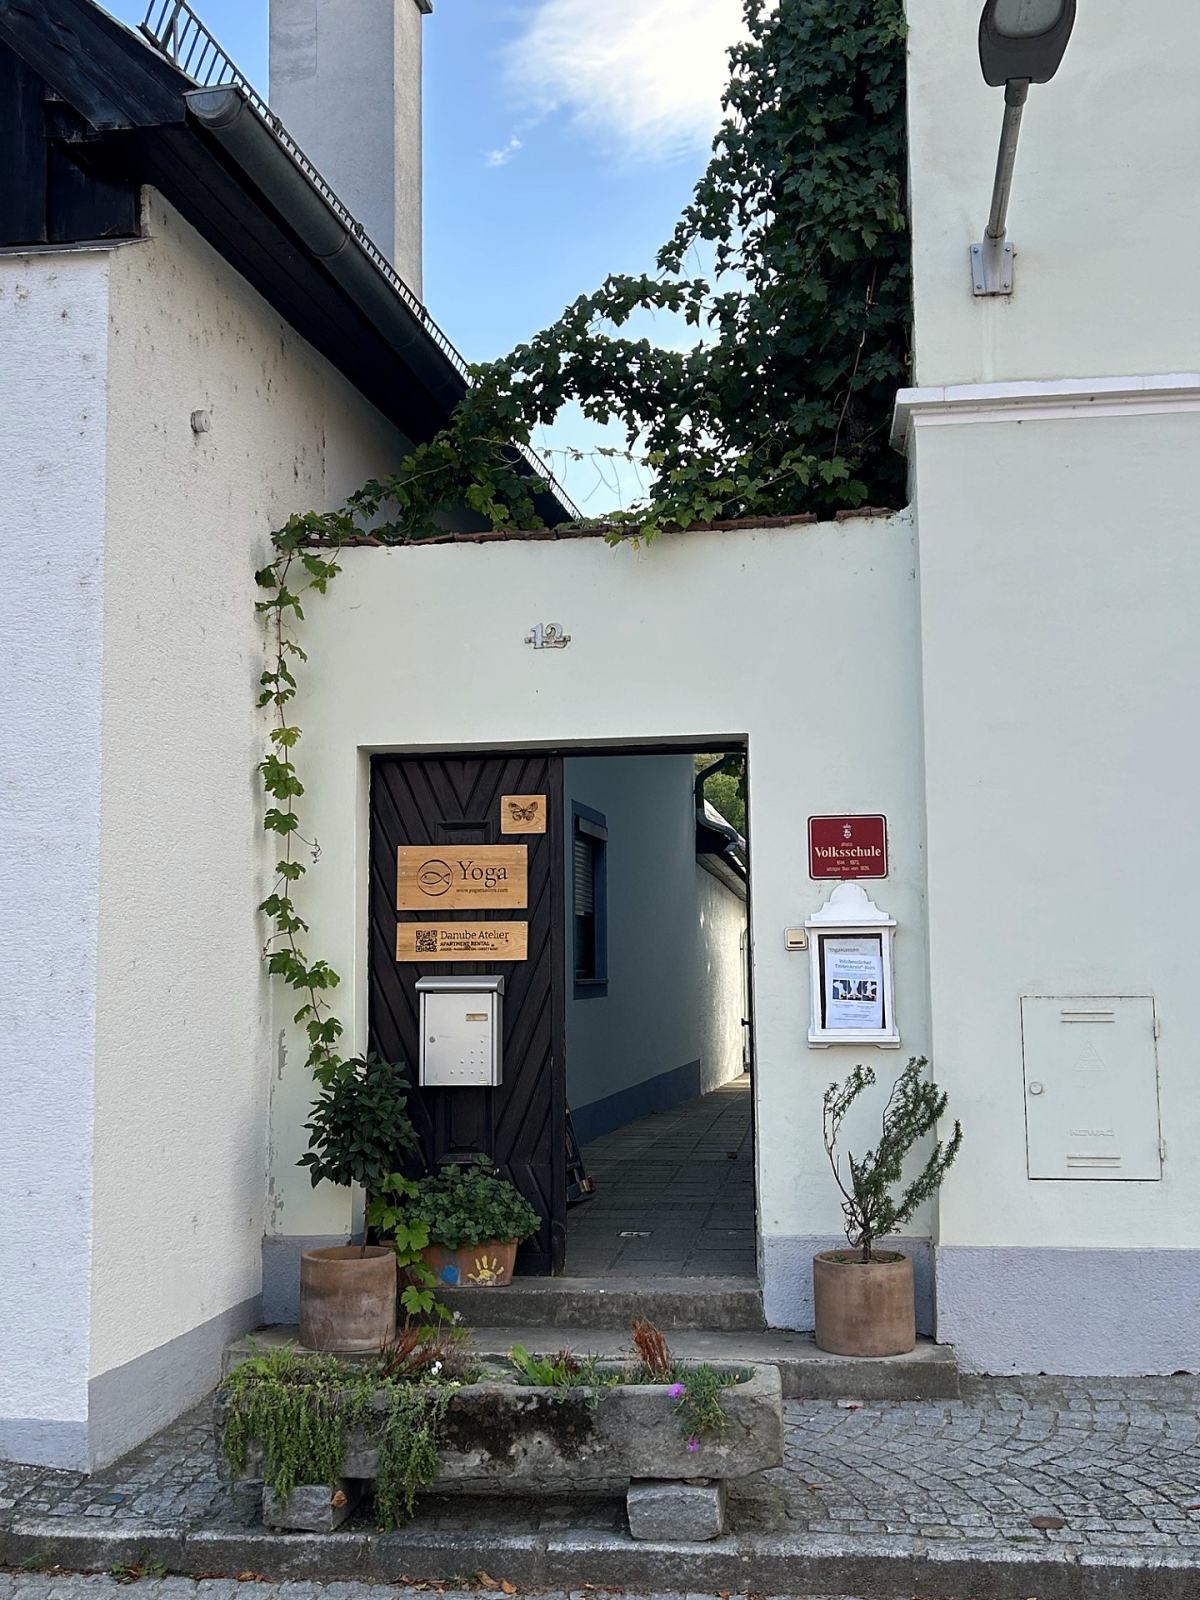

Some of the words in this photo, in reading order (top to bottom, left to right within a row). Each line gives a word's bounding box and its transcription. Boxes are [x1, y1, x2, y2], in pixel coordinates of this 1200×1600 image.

[529, 622, 568, 649] 12
[814, 846, 882, 858] Volksschule
[456, 860, 508, 888] Yoga
[440, 929, 477, 940] Danube
[478, 929, 510, 940] Atelier
